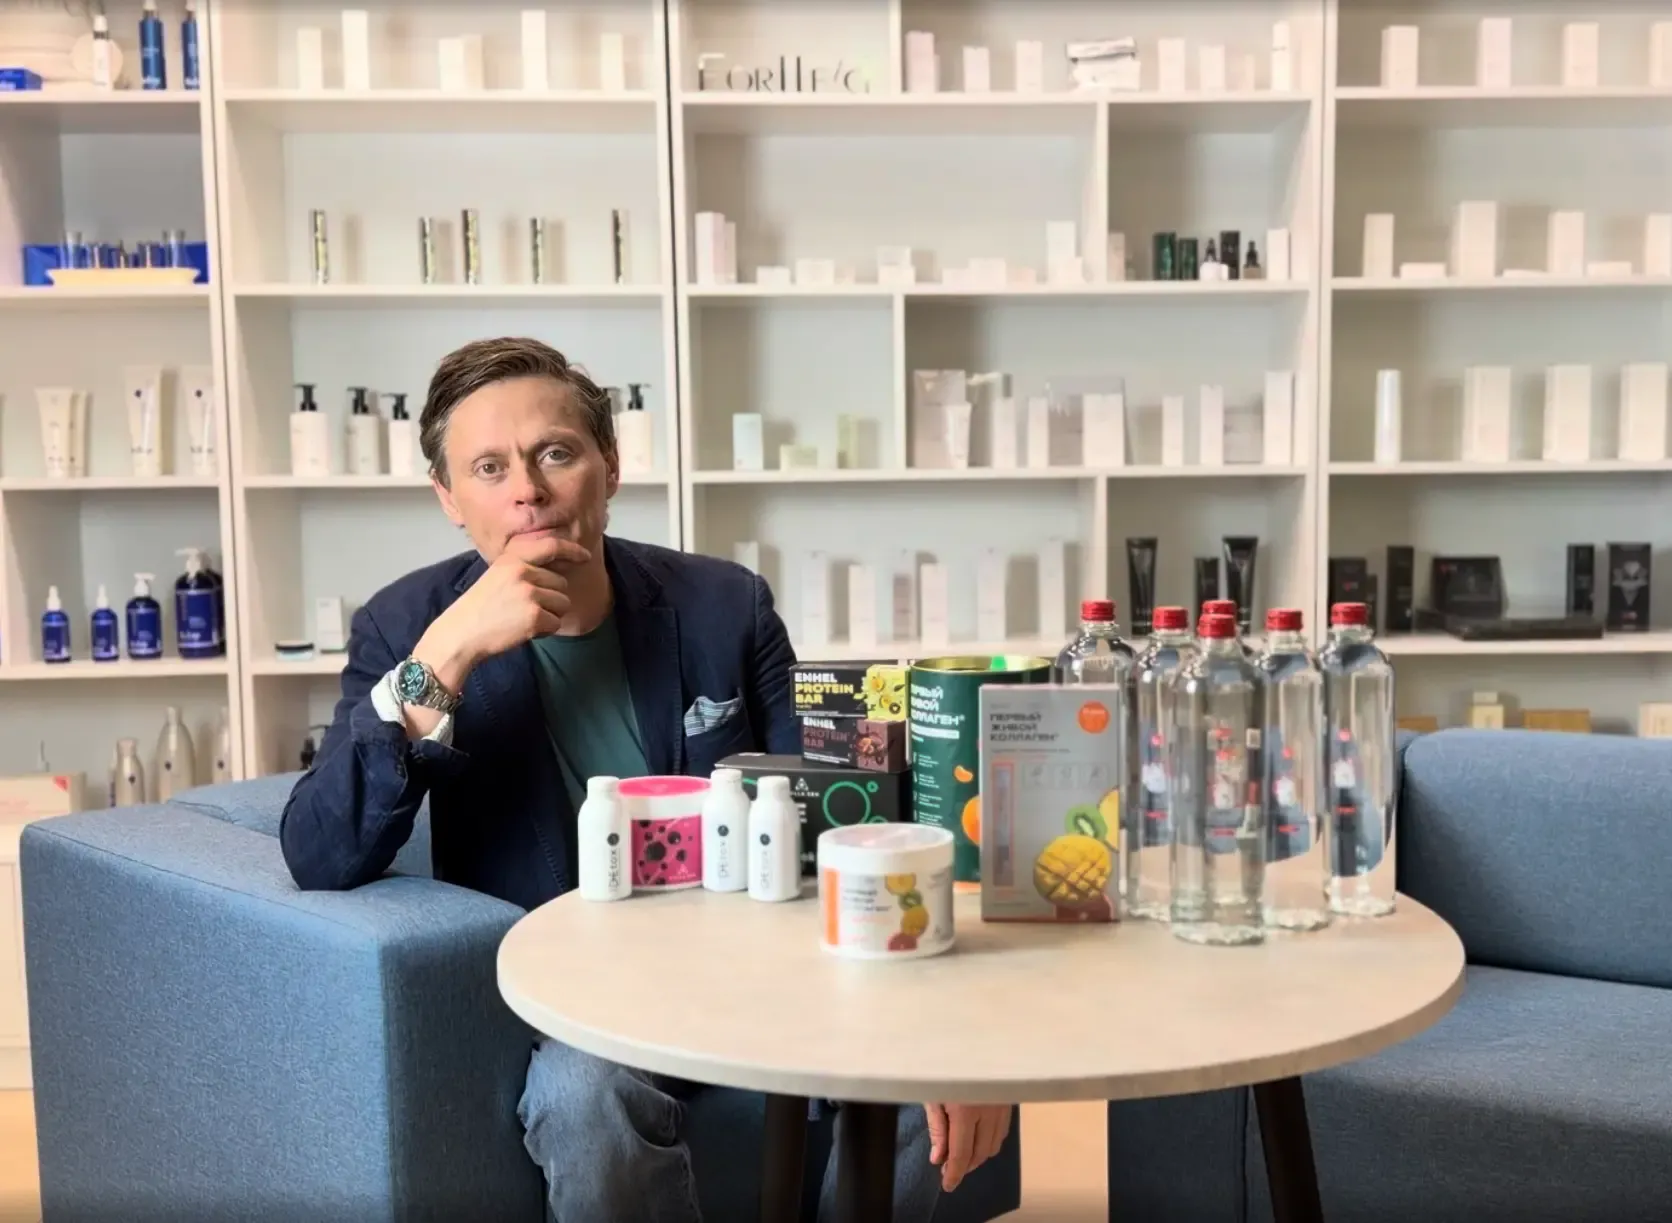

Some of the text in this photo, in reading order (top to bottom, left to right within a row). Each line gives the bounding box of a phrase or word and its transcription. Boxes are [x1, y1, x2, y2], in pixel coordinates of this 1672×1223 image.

[795, 672, 838, 683] ENHEL
[795, 683, 854, 694] PROTEIN
[795, 694, 824, 705] BAR
[990, 711, 1042, 722] ПЕРВЫЙ
[803, 727, 849, 742] PROTEIN
[803, 737, 825, 749] BAR
